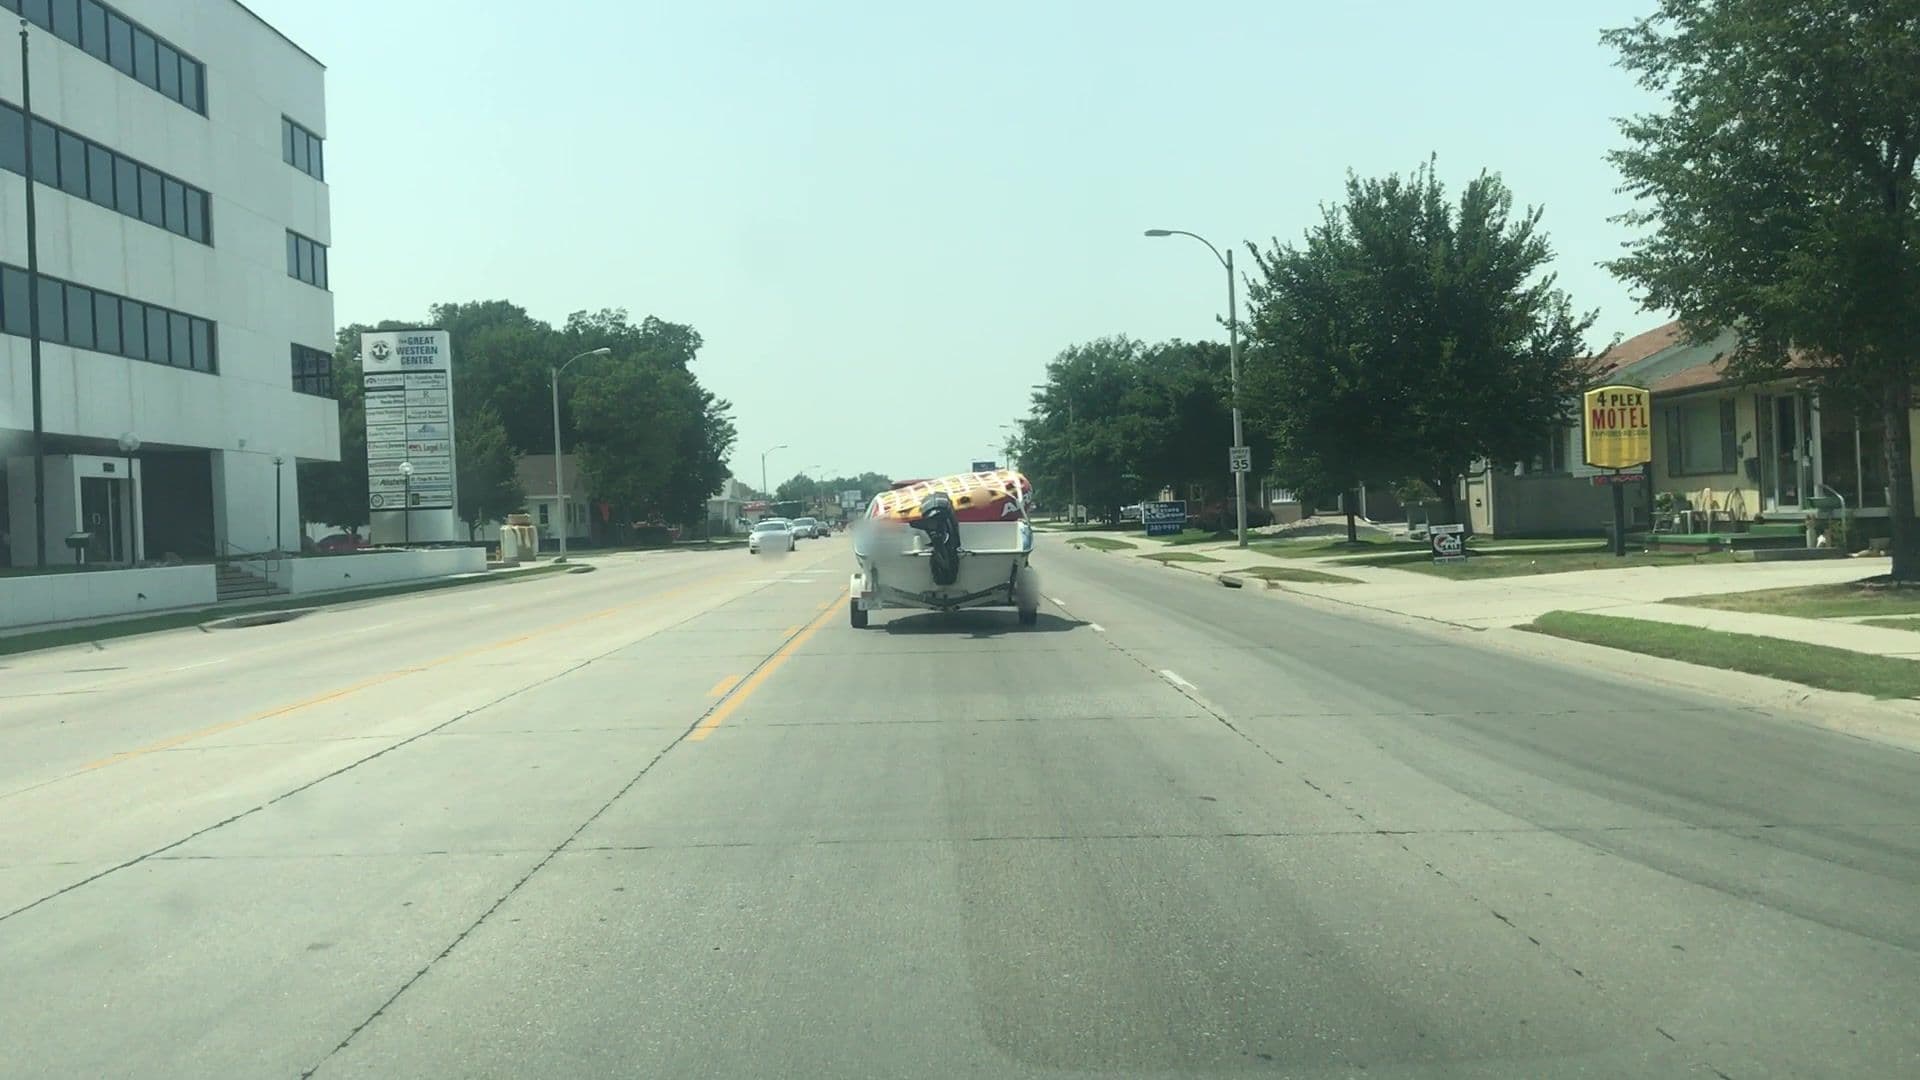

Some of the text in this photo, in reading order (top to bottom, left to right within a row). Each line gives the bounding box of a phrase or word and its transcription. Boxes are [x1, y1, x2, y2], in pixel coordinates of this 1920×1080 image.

[407, 336, 434, 345] GREAT
[396, 345, 438, 355] WESTERN
[400, 356, 434, 365] CENTRE
[1597, 391, 1642, 406] 4 PLEX
[1592, 407, 1648, 430] MOTEL
[1232, 459, 1249, 470] 35
